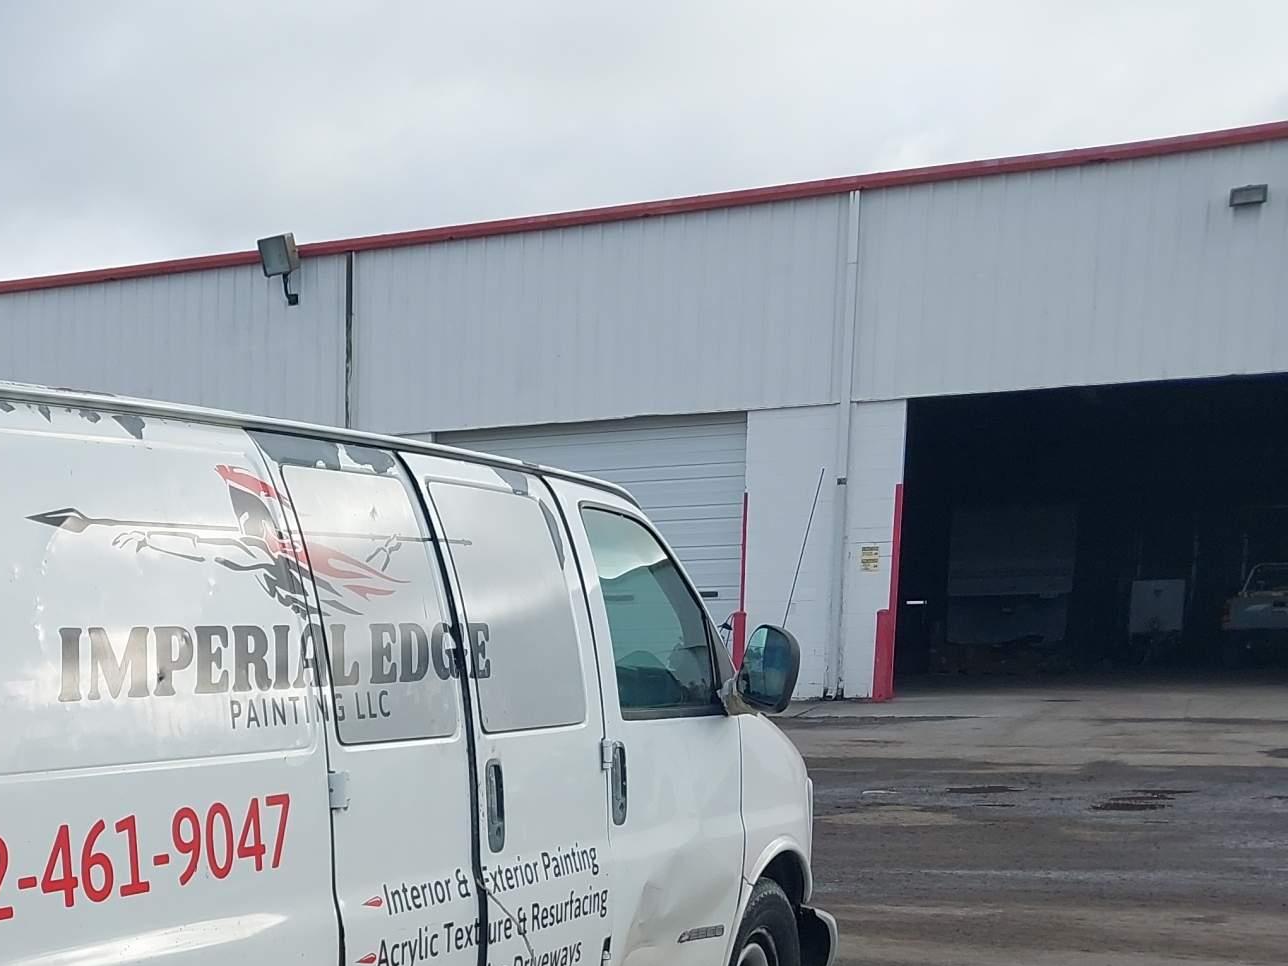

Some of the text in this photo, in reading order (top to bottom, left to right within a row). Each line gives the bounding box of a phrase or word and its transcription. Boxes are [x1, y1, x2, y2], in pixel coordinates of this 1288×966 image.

[58, 622, 491, 702] IMPERIAL EDGE
[231, 690, 391, 729] PAINTING LLC
[383, 872, 450, 916] Interior
[455, 868, 471, 899] &
[541, 843, 600, 886] Painting
[443, 917, 513, 953] Texture
[517, 907, 527, 936] &
[532, 885, 608, 932] Resurfacing
